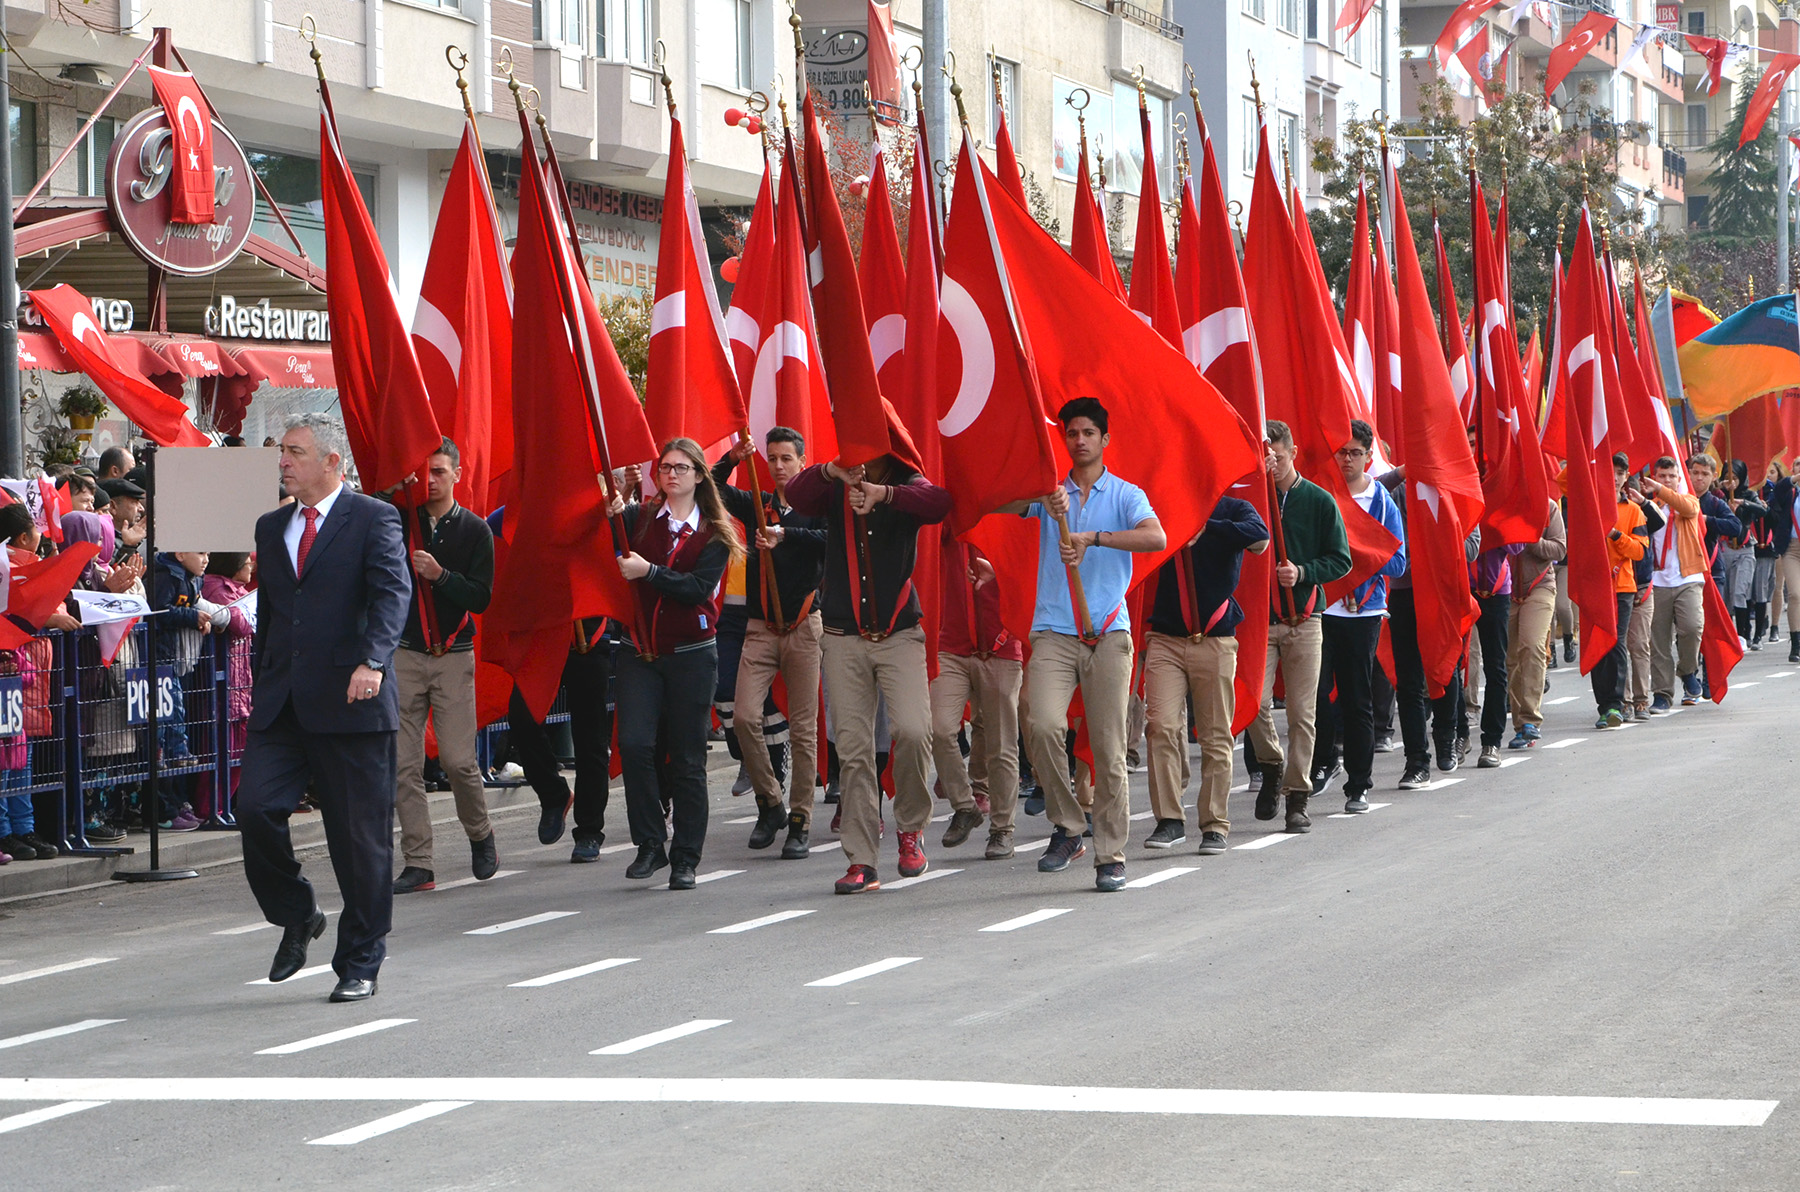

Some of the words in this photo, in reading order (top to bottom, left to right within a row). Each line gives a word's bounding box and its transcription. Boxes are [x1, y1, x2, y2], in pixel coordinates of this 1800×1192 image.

[565, 180, 621, 215] ENDER
[608, 226, 646, 253] BÜYÜK
[180, 344, 204, 362] Pera
[127, 676, 173, 721] POiS
